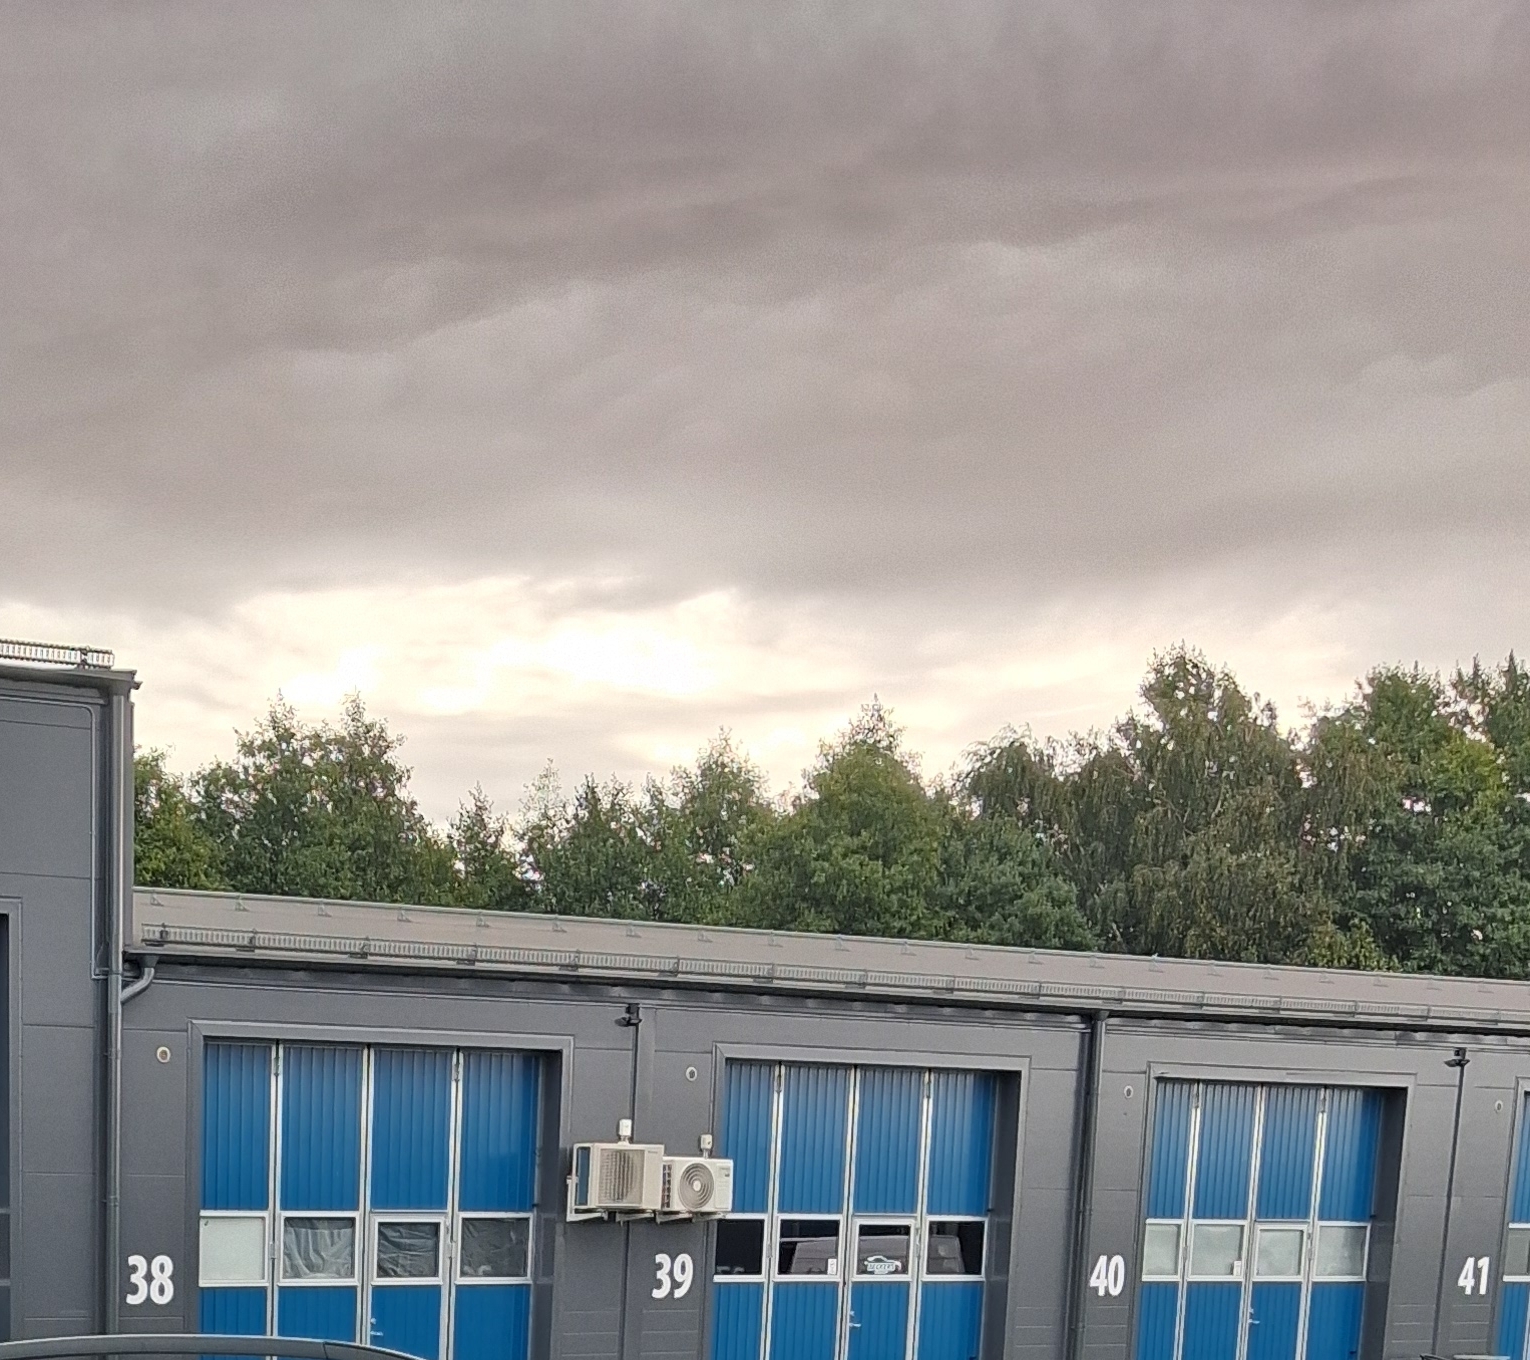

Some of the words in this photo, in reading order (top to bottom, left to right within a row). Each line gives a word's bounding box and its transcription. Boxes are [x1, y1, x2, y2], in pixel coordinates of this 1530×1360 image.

[126, 1254, 174, 1305] 38
[651, 1253, 693, 1299] 39
[1089, 1254, 1125, 1297] 40
[1457, 1256, 1490, 1295] 41
